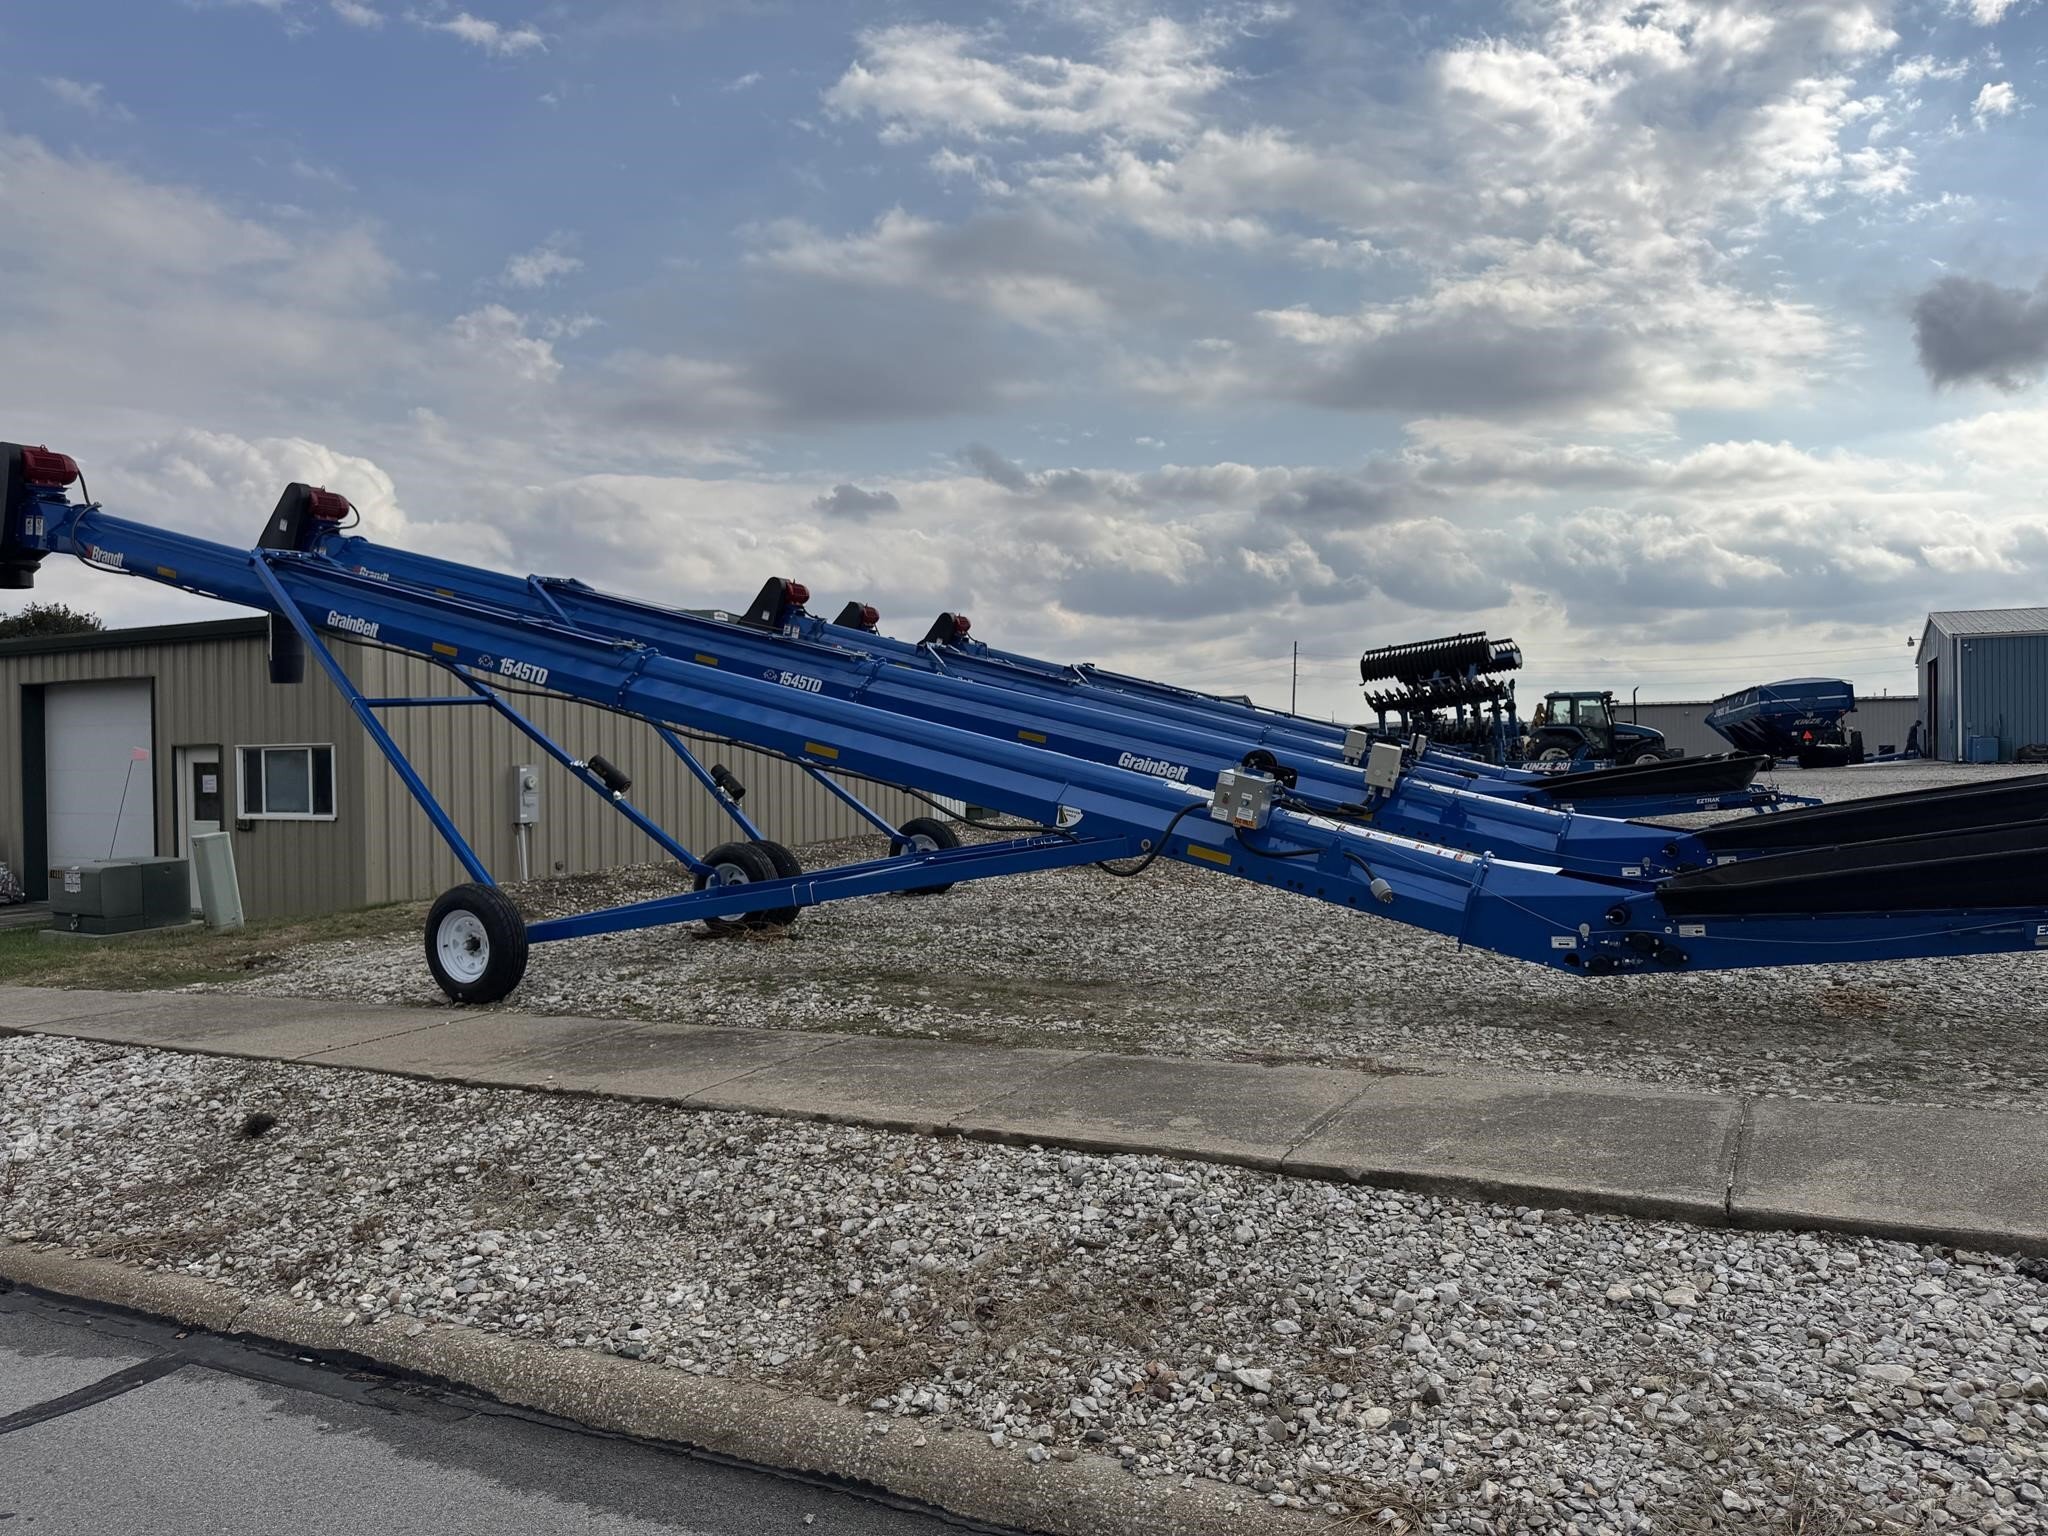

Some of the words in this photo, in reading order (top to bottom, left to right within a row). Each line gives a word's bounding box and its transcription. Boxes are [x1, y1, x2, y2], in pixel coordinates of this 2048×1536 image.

[91, 544, 124, 568] Brandt
[326, 609, 380, 639] GrainBelt
[500, 657, 549, 685] 1545TD
[779, 671, 823, 693] 1545TD
[1118, 751, 1189, 782] GrainBelt
[1521, 761, 1553, 770] KINZE
[1696, 796, 1720, 805] EZTRAK
[2036, 924, 2048, 936] E
